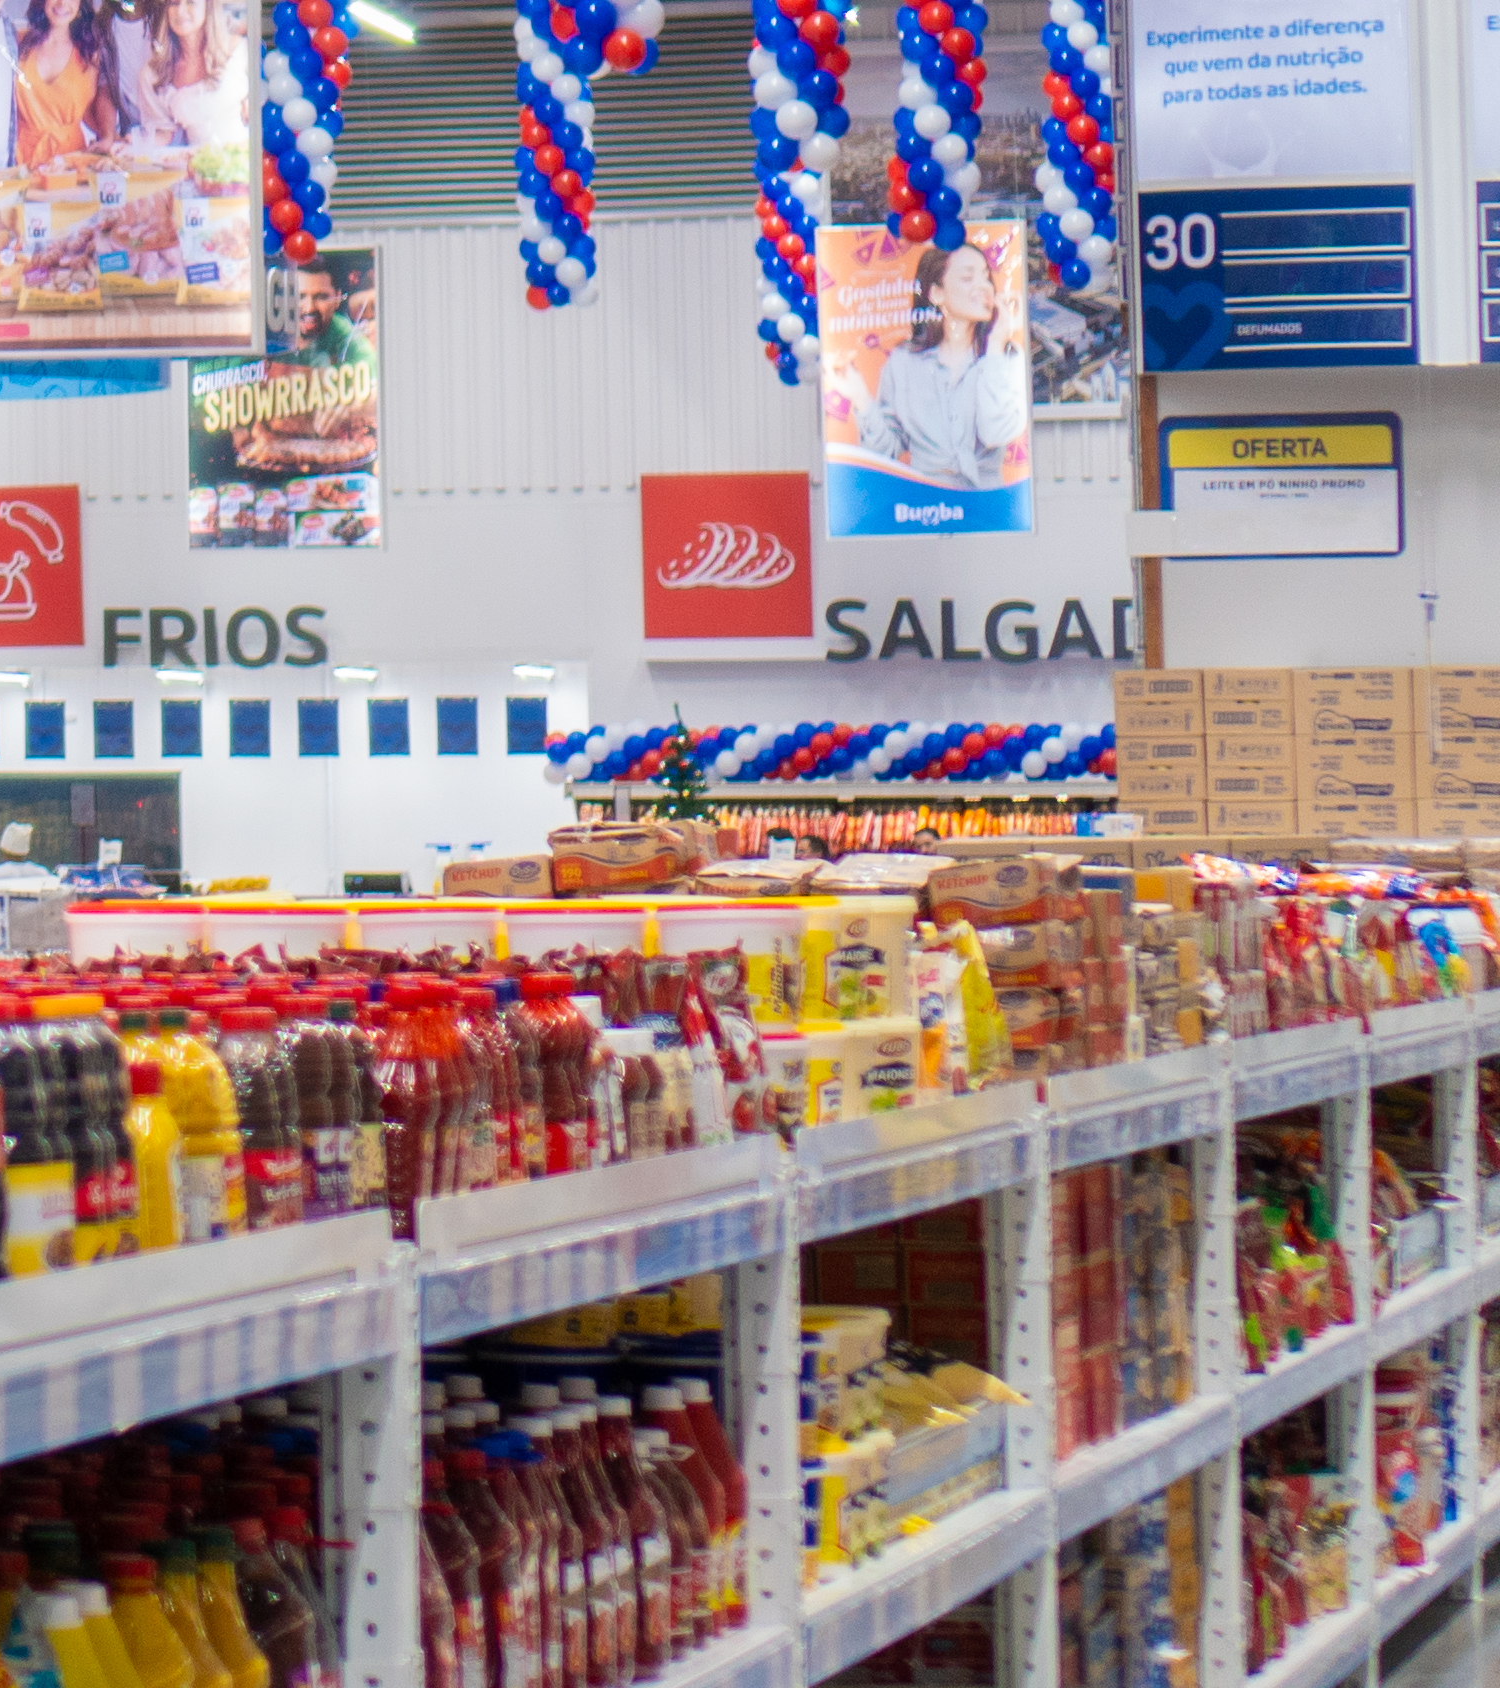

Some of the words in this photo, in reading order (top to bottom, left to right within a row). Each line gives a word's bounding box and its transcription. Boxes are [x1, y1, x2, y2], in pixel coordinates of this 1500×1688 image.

[1146, 25, 1265, 48] Experimente
[1269, 25, 1280, 38] a
[1285, 19, 1385, 37] diferença
[1164, 61, 1198, 78] que
[1203, 58, 1243, 71] vem
[1248, 52, 1271, 68] da
[1276, 47, 1364, 69] nutrição
[1163, 88, 1203, 108] para
[1208, 83, 1262, 100] todas
[1267, 84, 1289, 97] as
[1294, 77, 1368, 95] idades.
[1145, 214, 1216, 270] 30
[1233, 438, 1328, 459] OFERTA
[1203, 481, 1235, 490] LEITE
[1238, 481, 1255, 489] EM
[894, 502, 964, 525] Bumba
[102, 607, 329, 668] FRIOS
[451, 867, 503, 883] KETCHUP
